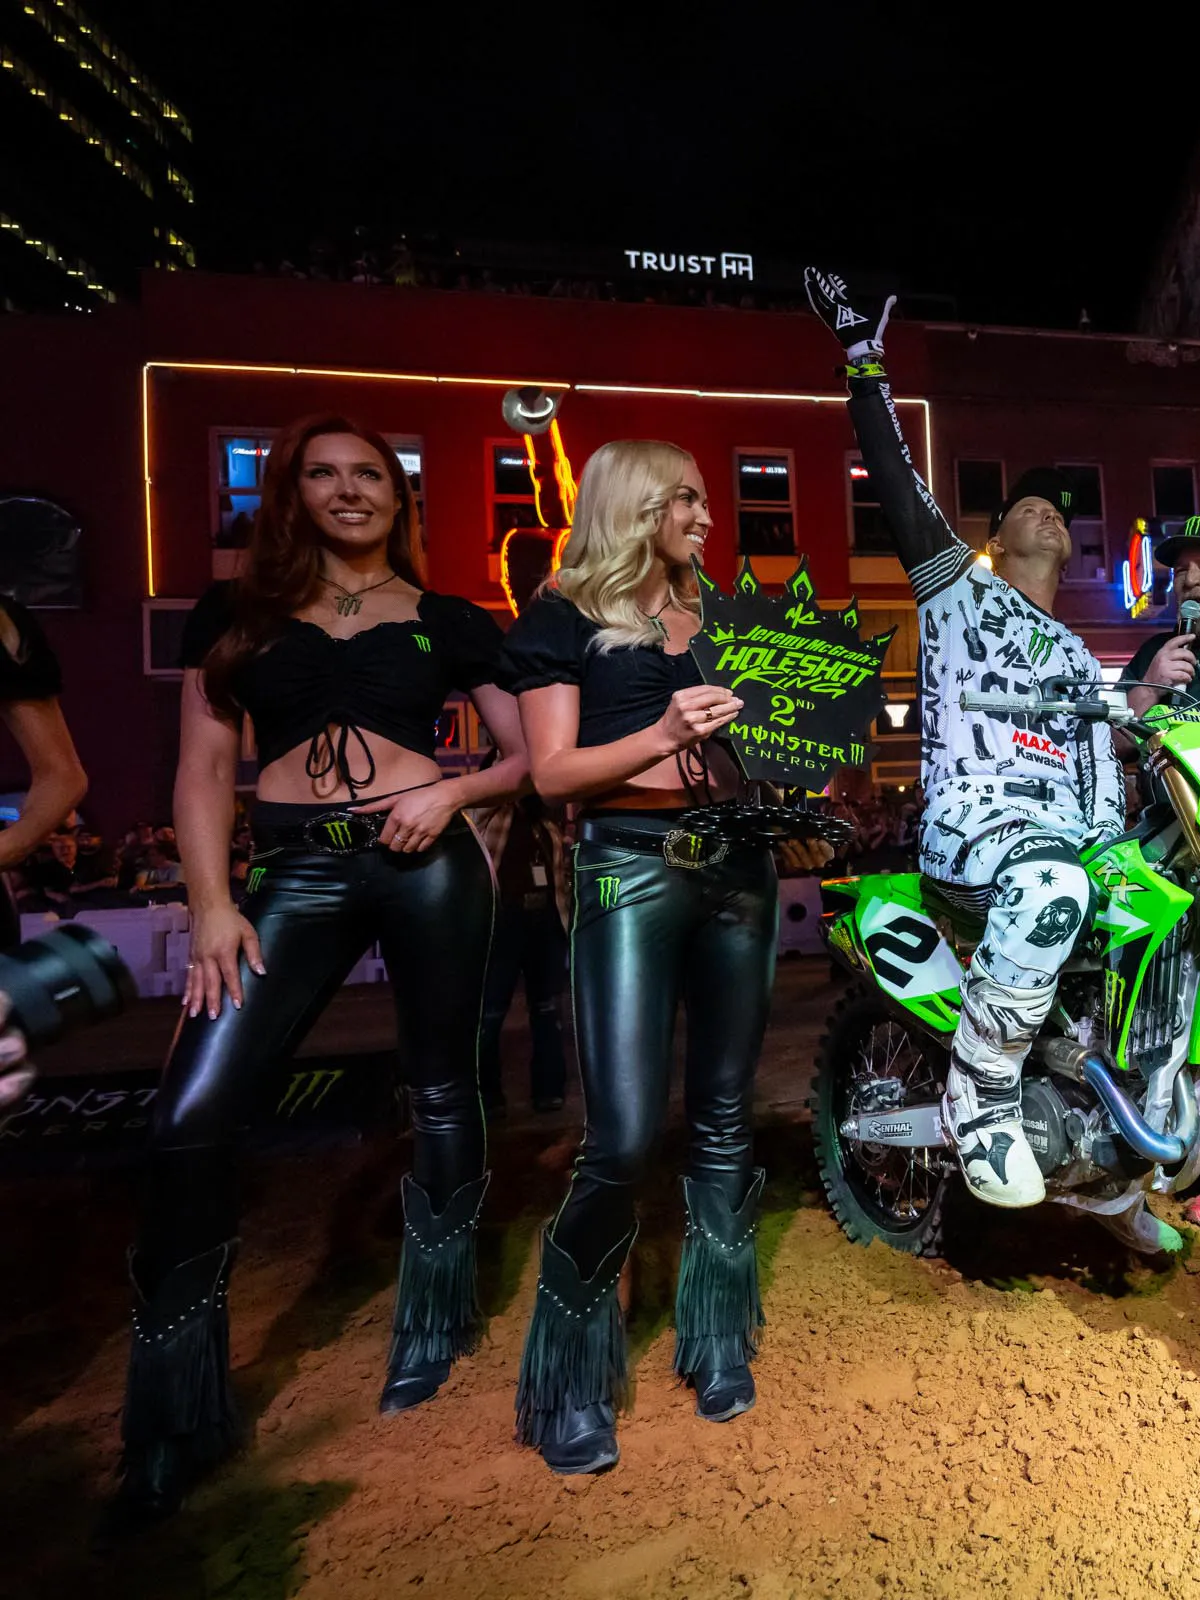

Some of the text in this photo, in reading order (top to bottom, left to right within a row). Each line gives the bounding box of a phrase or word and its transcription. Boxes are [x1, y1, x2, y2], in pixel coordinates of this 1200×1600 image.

[624, 249, 717, 275] TRUIST
[737, 625, 881, 667] Jeremy McGrath's
[715, 645, 876, 687] HOLESHOT
[728, 722, 847, 763] MONSTER
[745, 746, 829, 772] ENERGY
[1009, 836, 1064, 860] CASH
[864, 915, 941, 990] 2
[868, 1120, 913, 1139] RENTHAL
